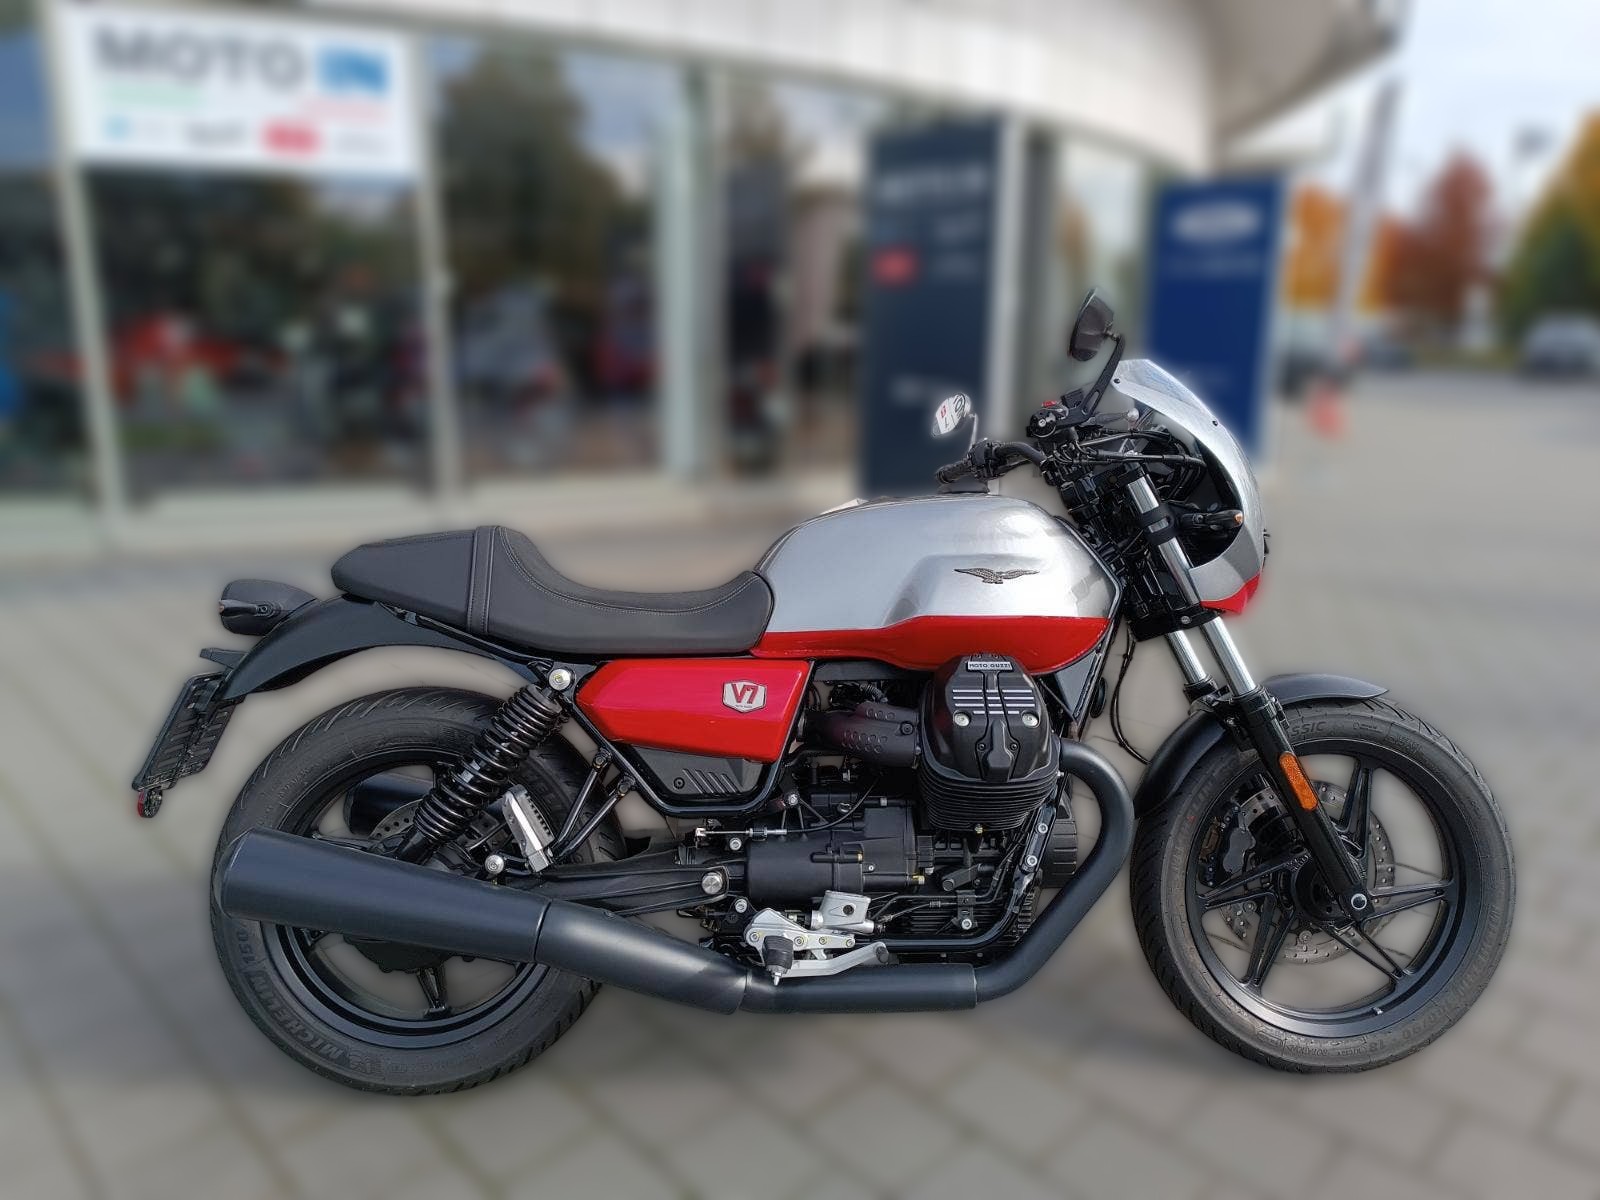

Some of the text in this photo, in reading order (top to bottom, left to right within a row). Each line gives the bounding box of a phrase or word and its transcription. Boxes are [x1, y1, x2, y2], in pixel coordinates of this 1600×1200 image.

[96, 26, 305, 92] MOTO
[731, 683, 759, 704] V7
[1290, 721, 1327, 738] SSIC
[248, 969, 346, 1060] MICHELIN
